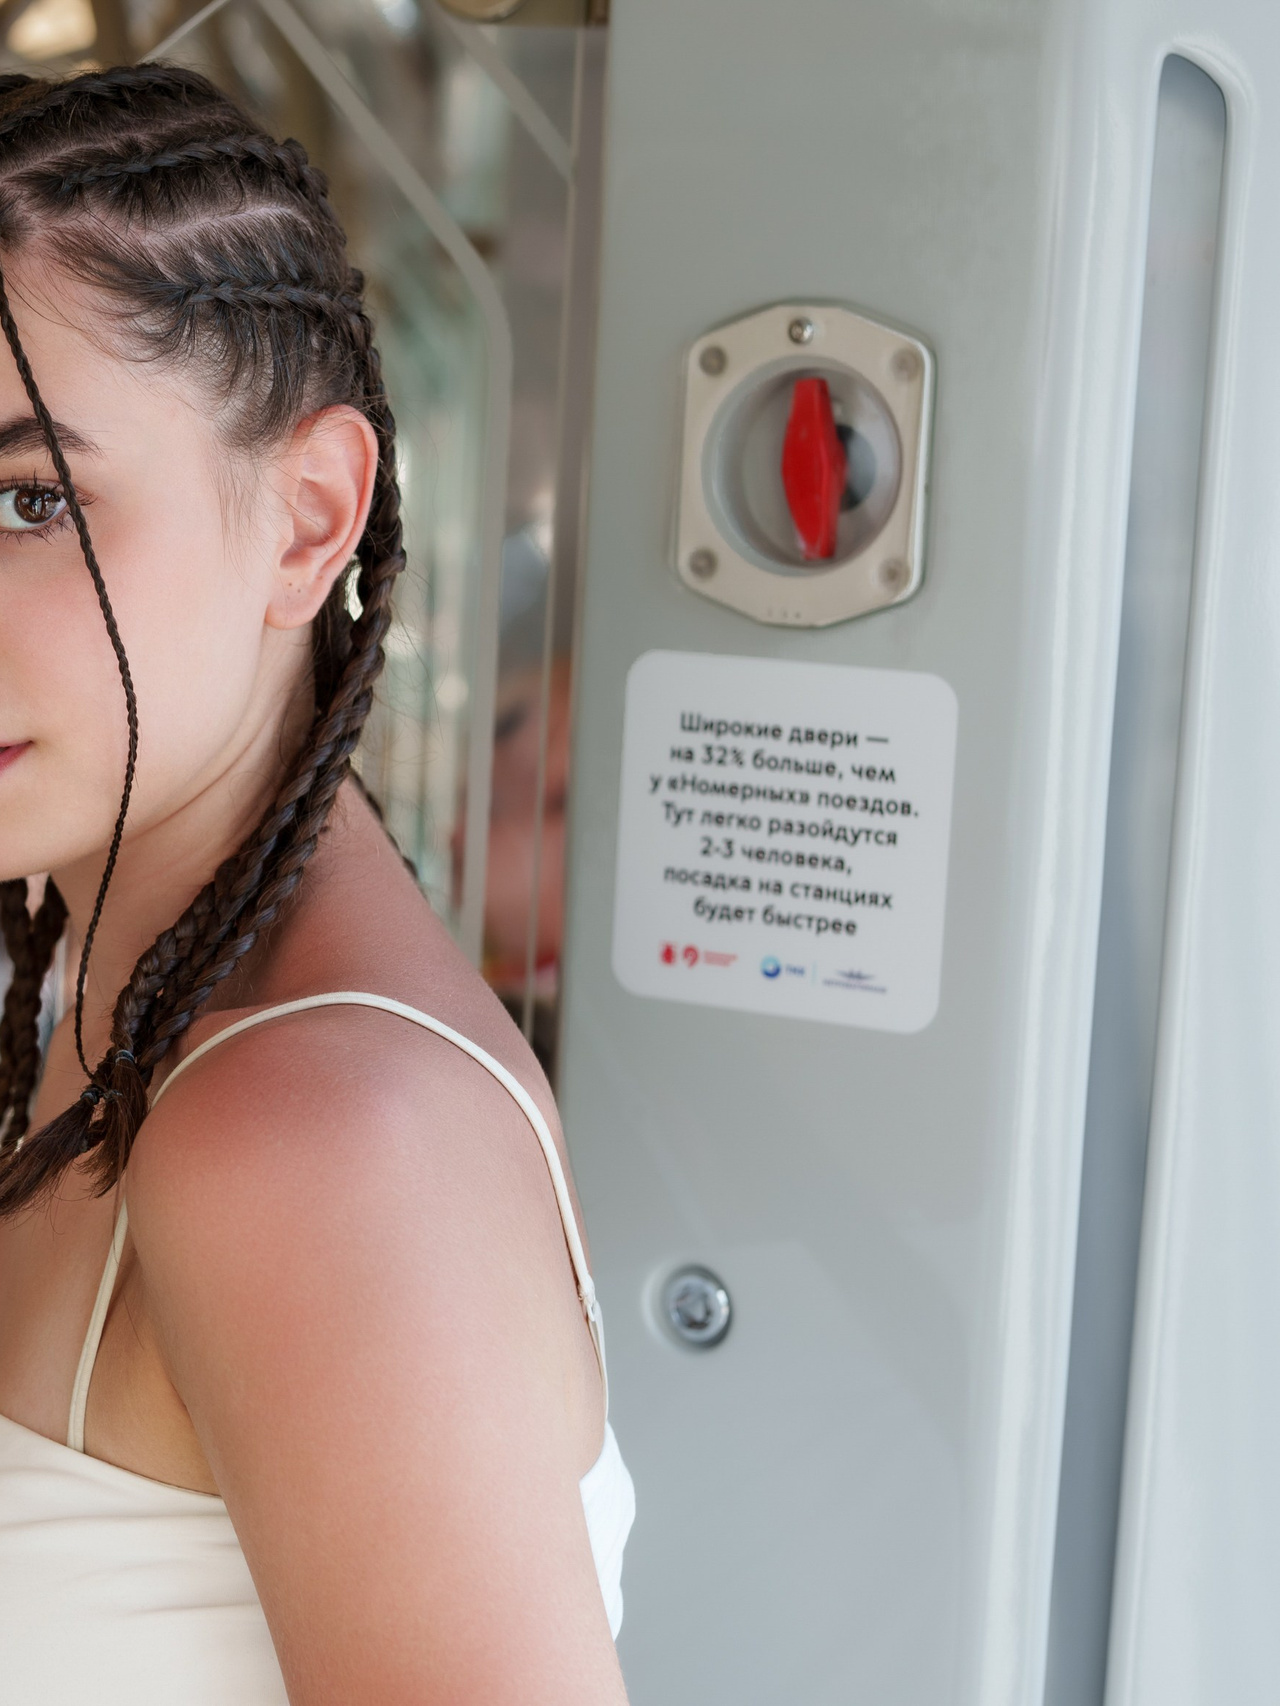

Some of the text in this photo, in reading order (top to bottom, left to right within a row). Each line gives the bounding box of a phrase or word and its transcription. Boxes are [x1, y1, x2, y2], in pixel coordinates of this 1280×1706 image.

[680, 712, 782, 738] Широкие
[788, 726, 858, 750] двери
[670, 744, 896, 782] на 32% больше, чем
[650, 773, 919, 817] у «Номерных» поездов.
[664, 801, 897, 847] Тут легко разойдутся
[701, 836, 853, 875] 2-3 человека,
[664, 867, 892, 909] посадка на станциях
[693, 896, 857, 936] будет быстрее
